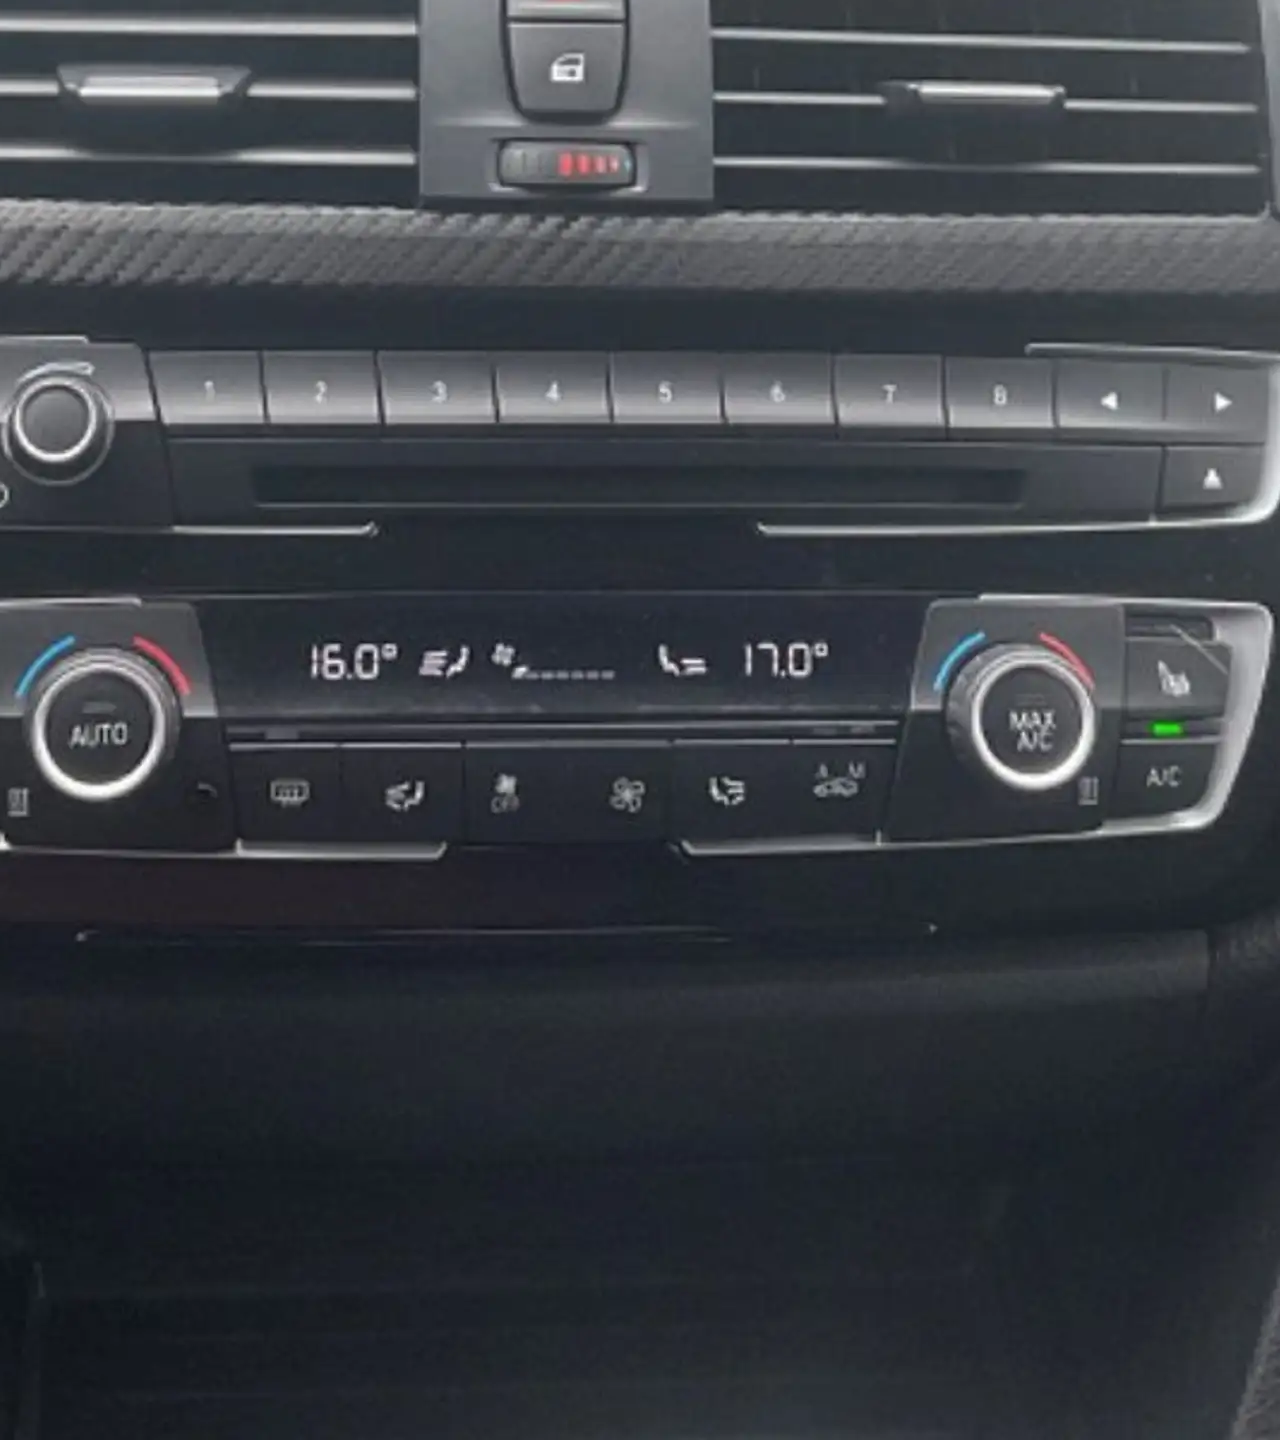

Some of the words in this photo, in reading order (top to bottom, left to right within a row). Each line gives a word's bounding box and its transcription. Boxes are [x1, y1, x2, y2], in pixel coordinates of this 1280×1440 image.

[314, 380, 327, 404] 2
[432, 380, 447, 404] 3
[545, 380, 560, 402] 4
[659, 381, 672, 403] 5
[770, 381, 785, 403] 6
[882, 384, 897, 404] 7
[1009, 710, 1055, 731] MAX
[68, 722, 128, 749] AUTO
[1017, 728, 1053, 752] A/C
[1146, 766, 1182, 788] A/C
